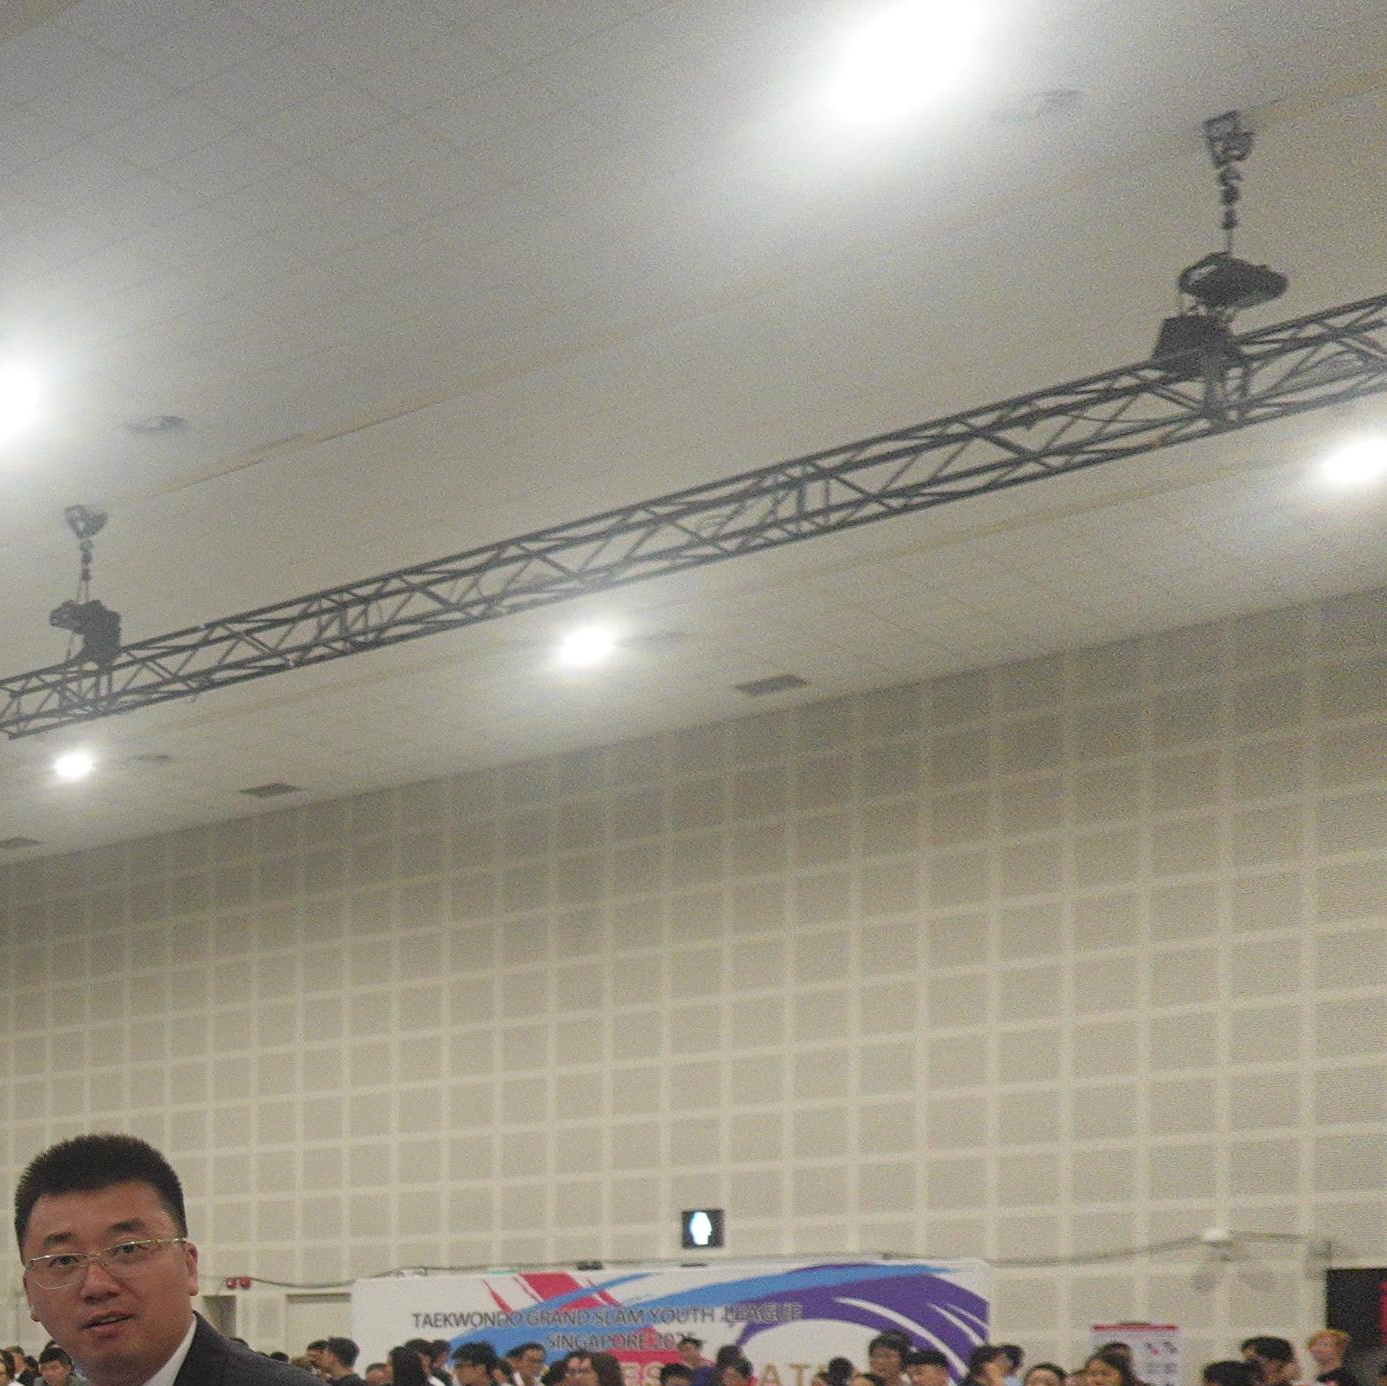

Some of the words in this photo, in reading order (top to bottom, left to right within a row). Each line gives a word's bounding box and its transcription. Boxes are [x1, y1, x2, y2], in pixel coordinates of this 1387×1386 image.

[412, 1311, 523, 1329] TAEKWONDO
[526, 1309, 590, 1327] GRAND
[594, 1308, 645, 1325] SLAM
[648, 1306, 716, 1324] YOUTH
[545, 1332, 647, 1351] SINGAPORE
